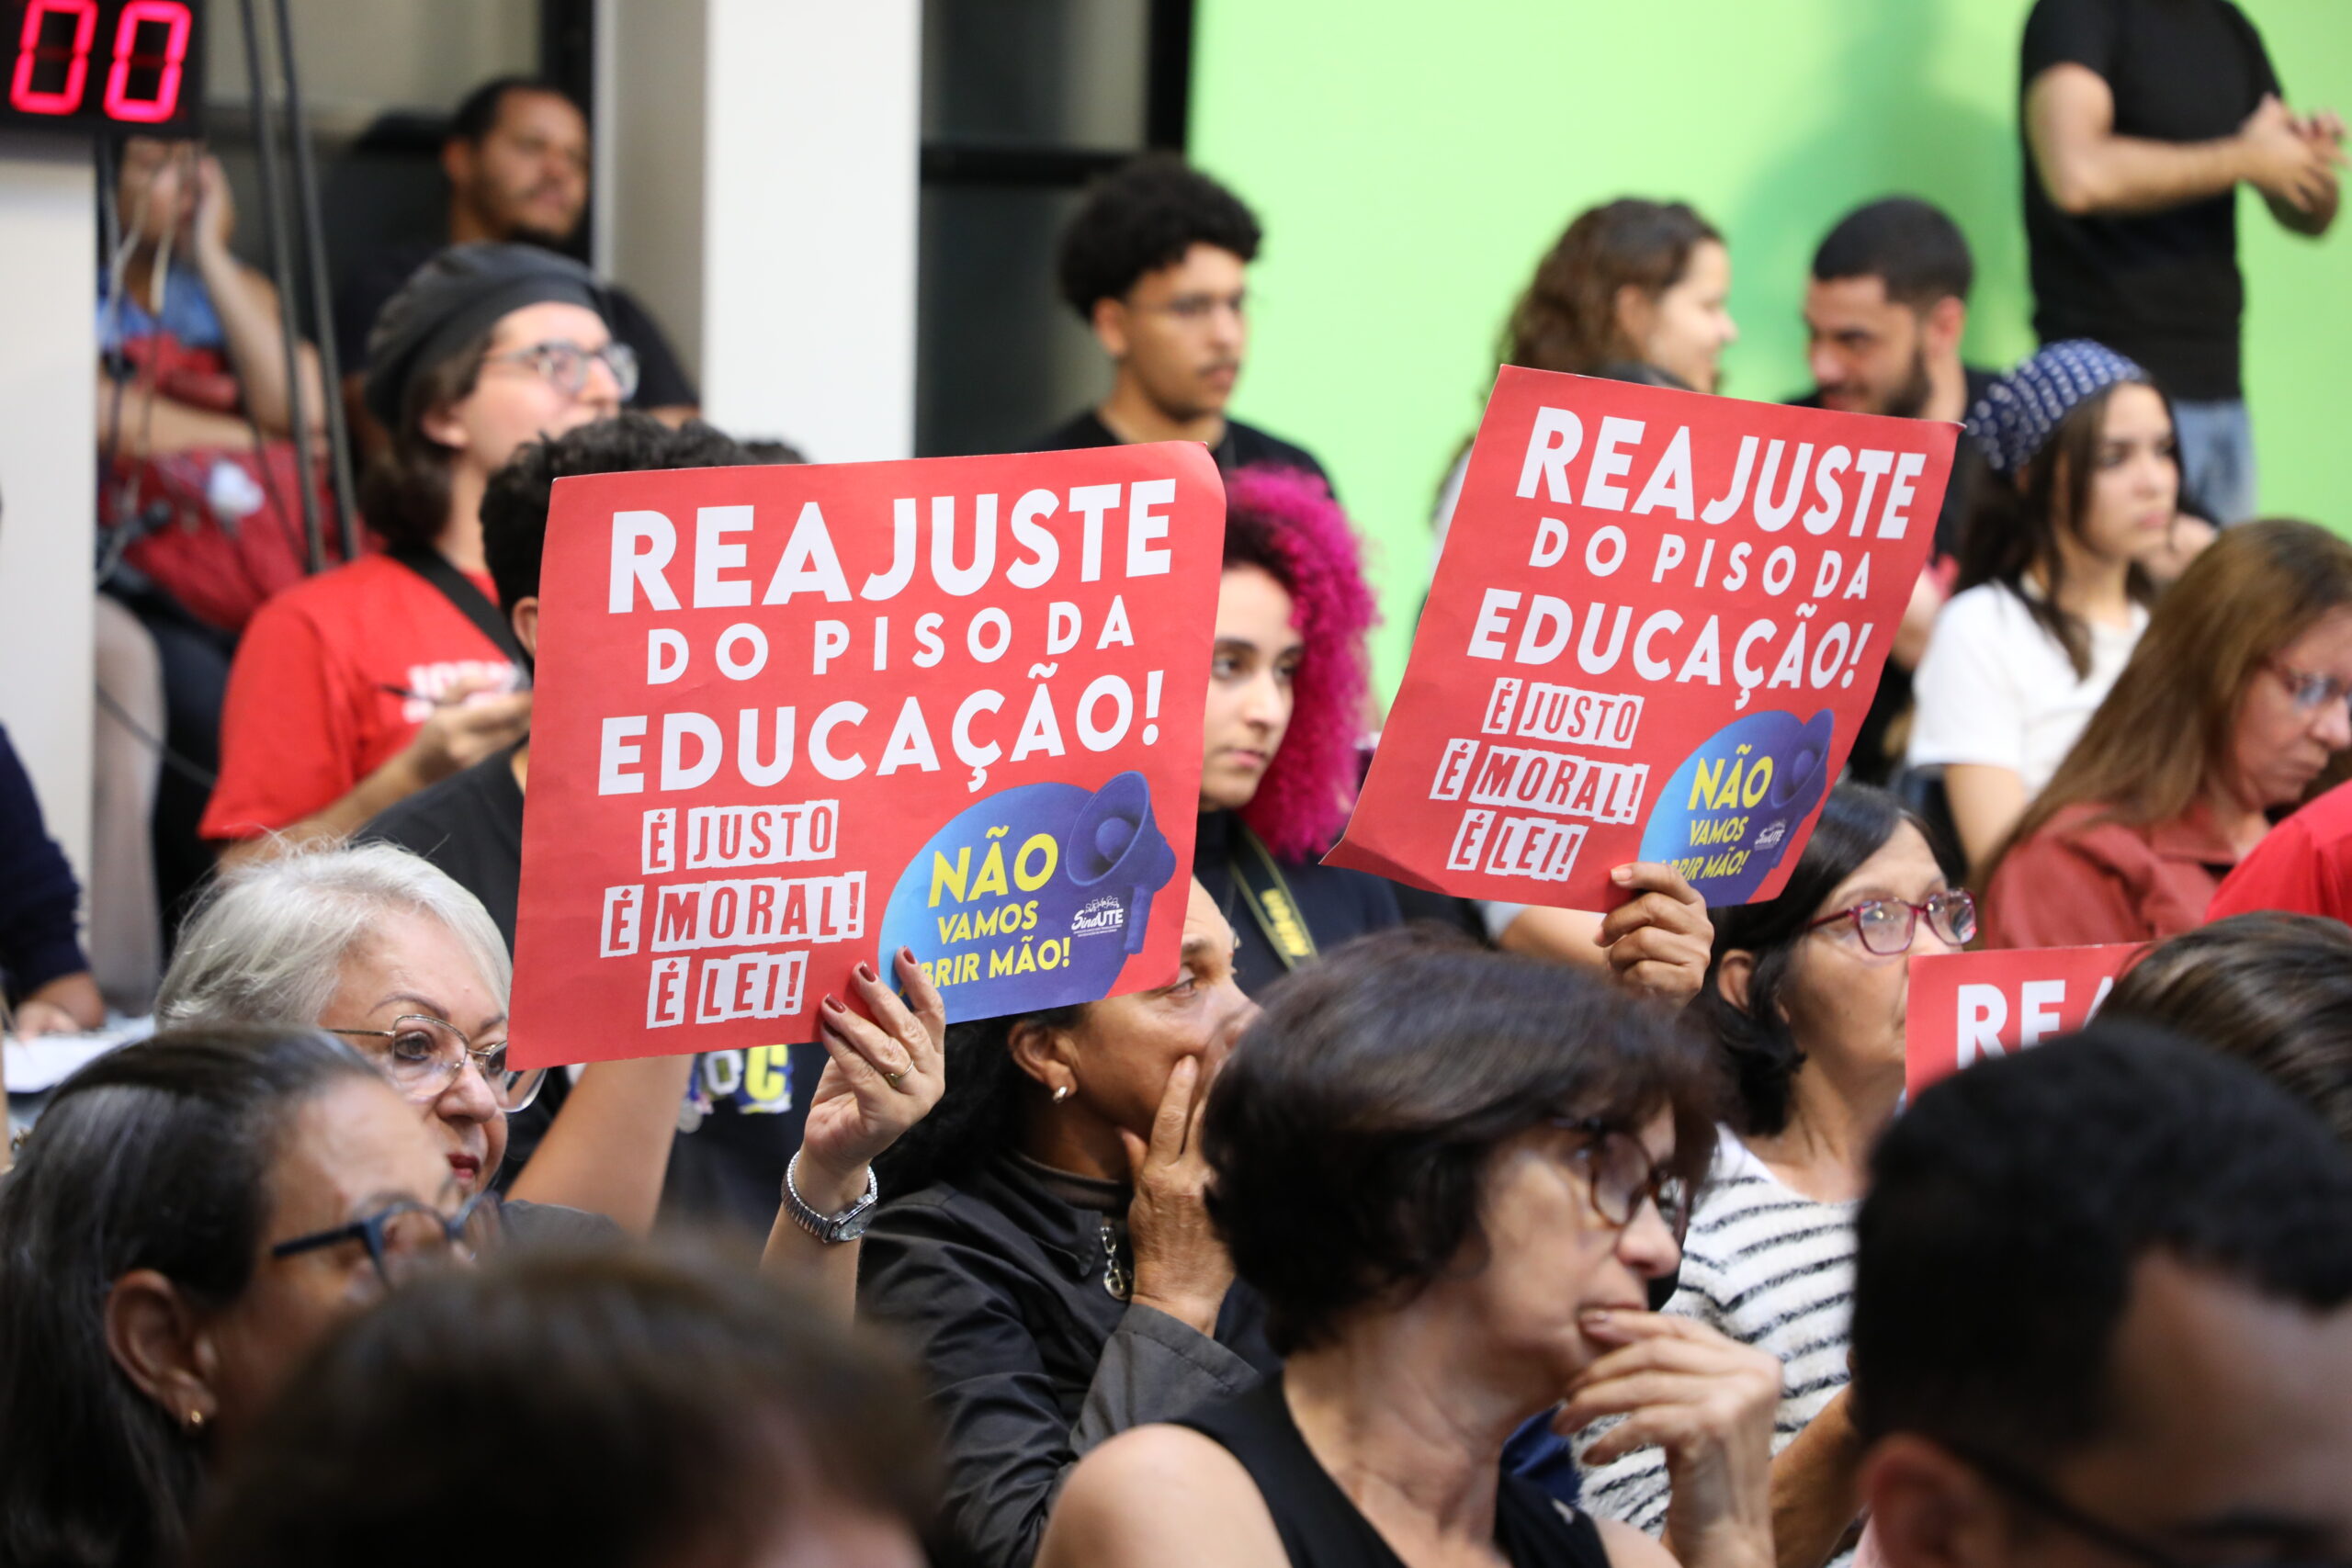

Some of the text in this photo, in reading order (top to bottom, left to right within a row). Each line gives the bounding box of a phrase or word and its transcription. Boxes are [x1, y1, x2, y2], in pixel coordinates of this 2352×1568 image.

[9, 0, 192, 124] 00
[1516, 406, 1927, 540] REAJUSTE
[608, 479, 1177, 614] REAJUSTE
[1528, 516, 1871, 600] DO PISO DA
[647, 594, 1136, 684] DO PISO DA
[1466, 587, 1873, 710] EDUCAÇÃO!
[598, 662, 1164, 795] EDUCAÇÃO!
[1487, 681, 1637, 743] É JUSTO
[1437, 741, 1644, 818] É MORAL!
[1687, 743, 1774, 811] NÃO
[649, 806, 832, 870] É JUSTO
[927, 825, 1058, 908] NÃO
[1453, 812, 1581, 875] É LEI!
[1690, 816, 1749, 847] VAMOS
[1700, 845, 1751, 880] MÃO!
[608, 881, 861, 952] É MORAL!
[937, 899, 1039, 946] VAMOS
[654, 959, 802, 1022] É LEI!
[899, 935, 1071, 998] BRIR MÃO!
